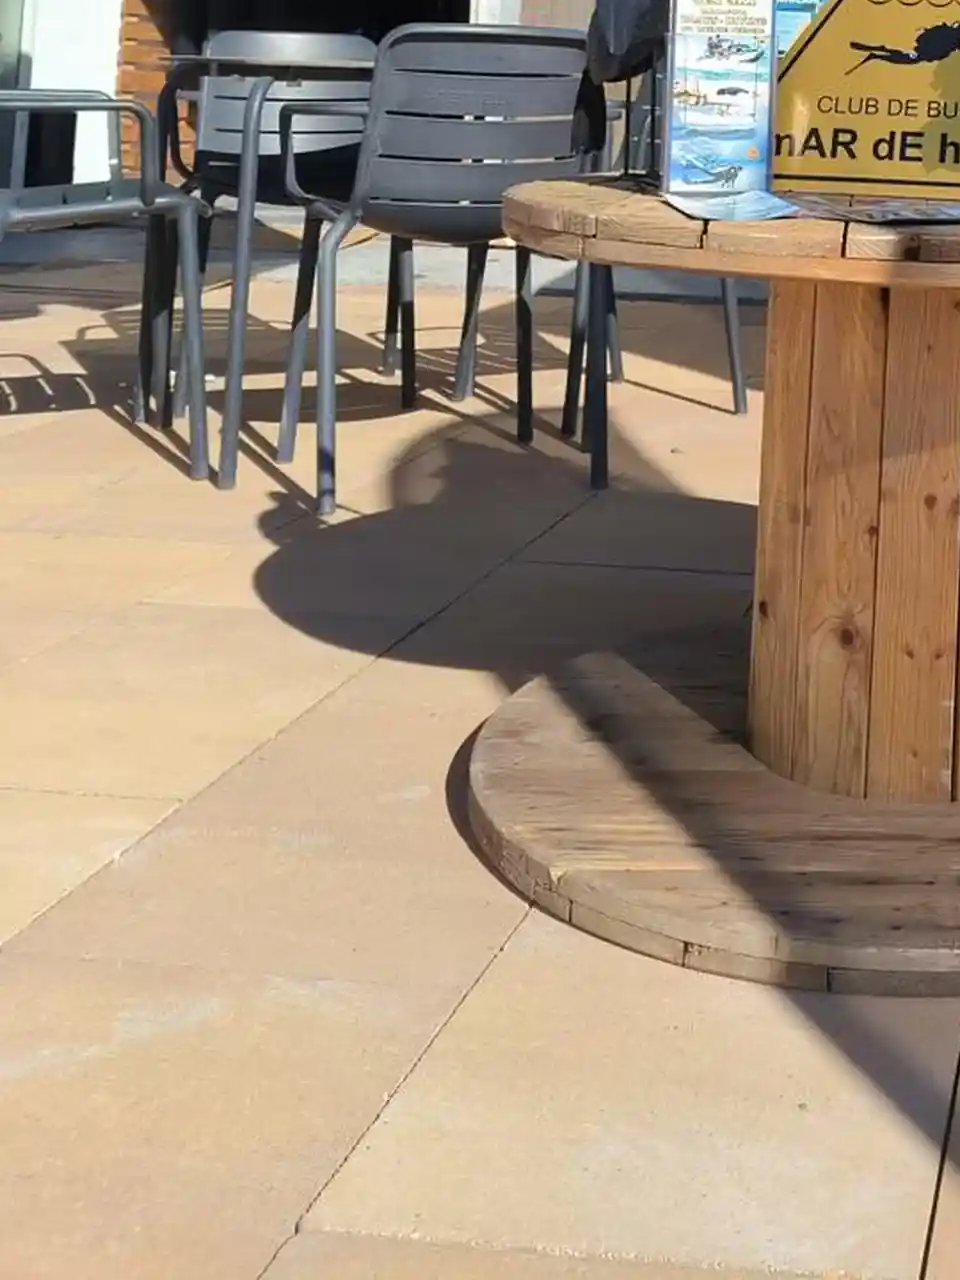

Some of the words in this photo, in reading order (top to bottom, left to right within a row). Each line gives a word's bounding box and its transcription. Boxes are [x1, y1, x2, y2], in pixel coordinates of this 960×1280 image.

[817, 95, 879, 115] CLUB
[887, 98, 920, 118] DE
[872, 130, 925, 163] dE
